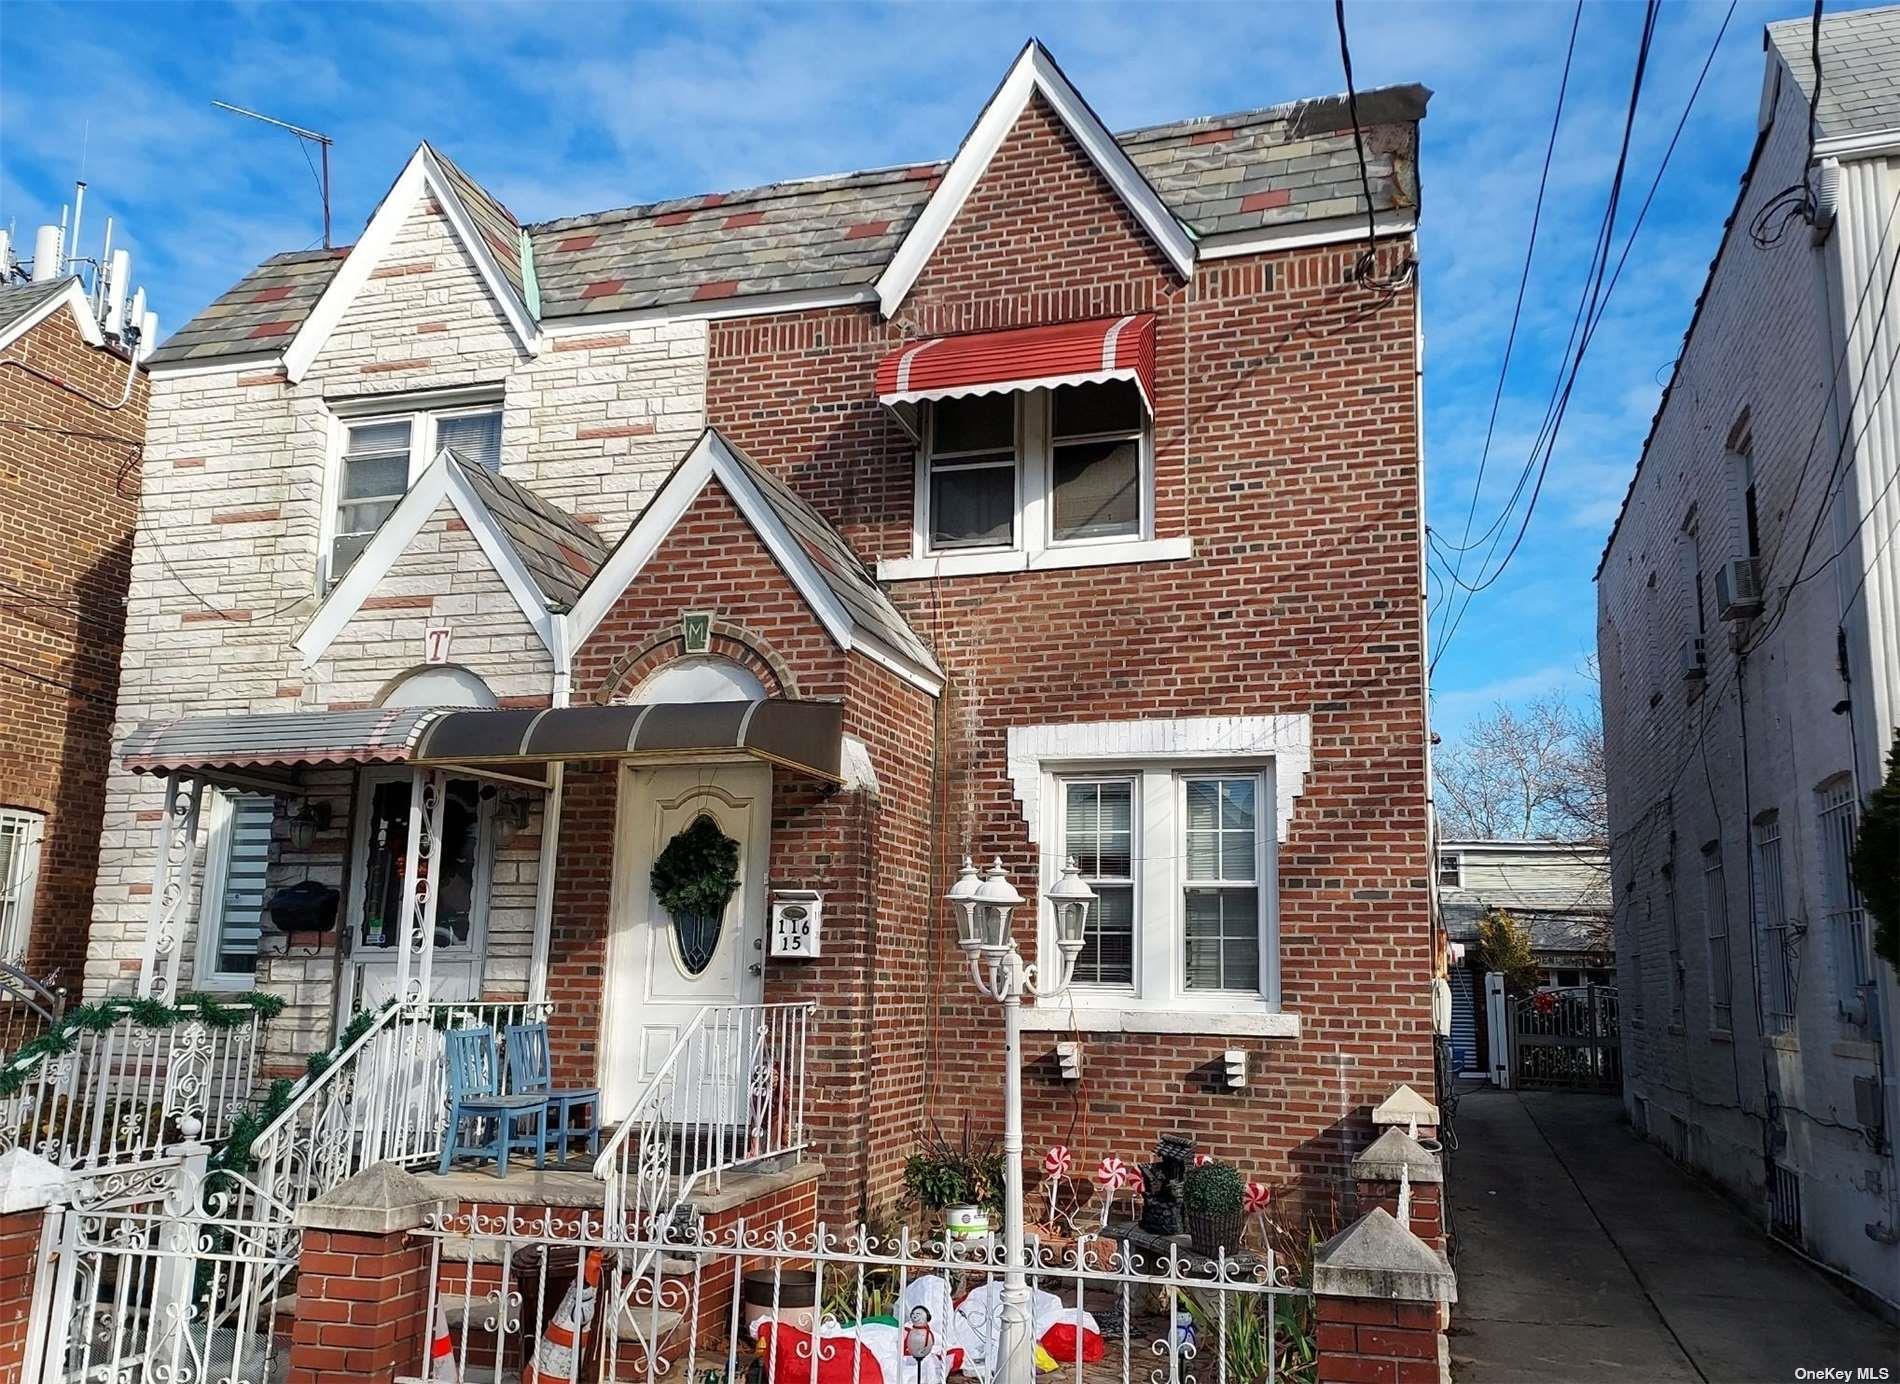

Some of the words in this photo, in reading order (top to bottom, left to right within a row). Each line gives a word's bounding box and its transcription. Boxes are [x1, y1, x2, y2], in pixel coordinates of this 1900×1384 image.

[689, 622, 705, 643] M
[429, 630, 450, 661] T
[778, 919, 810, 935] 116
[782, 936, 801, 951] 15
